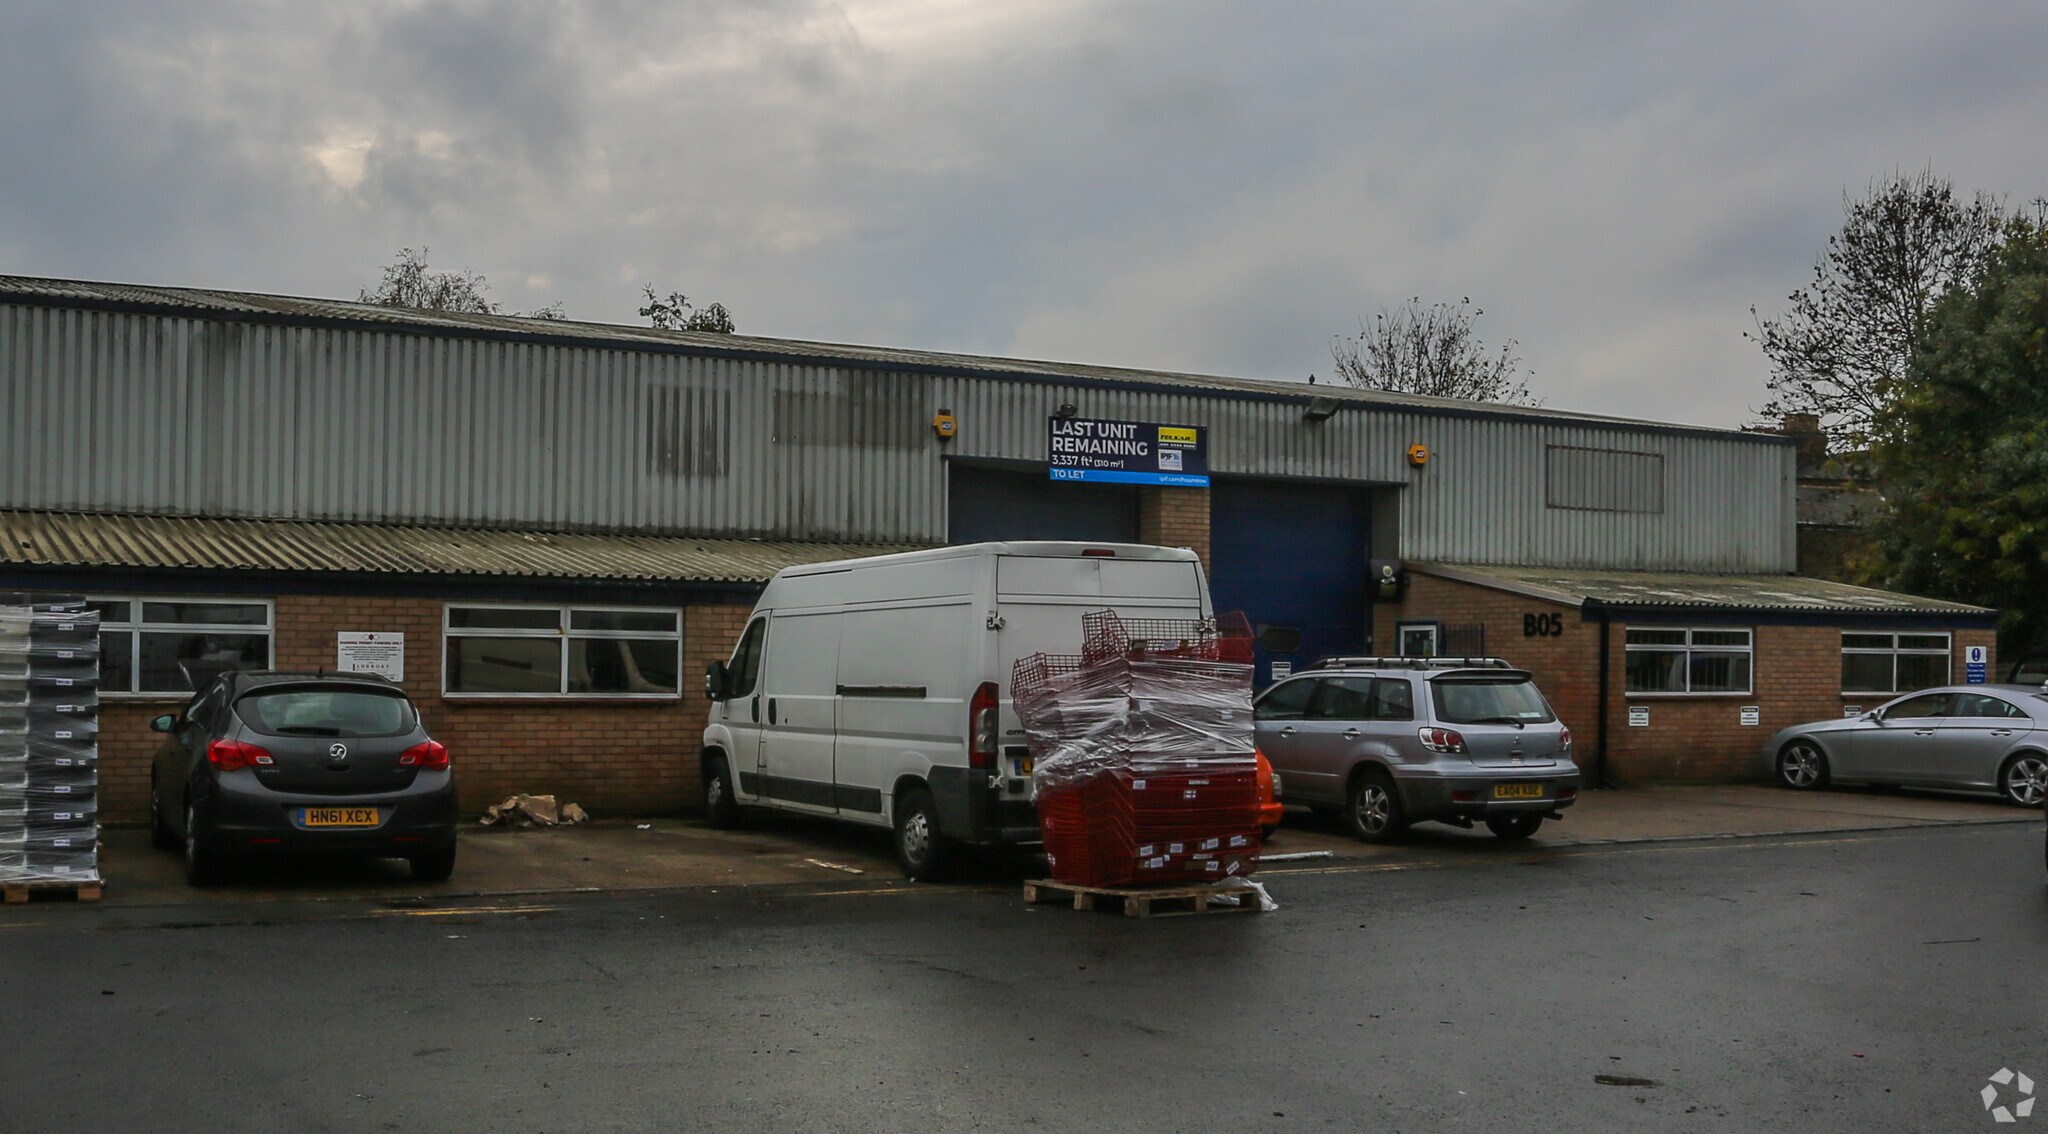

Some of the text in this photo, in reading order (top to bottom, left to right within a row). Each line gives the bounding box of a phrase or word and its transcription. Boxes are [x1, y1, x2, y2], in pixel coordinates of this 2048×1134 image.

[1052, 420, 1137, 439] LAST UNIT
[1052, 437, 1148, 456] REMAINING
[1052, 454, 1078, 466] 3,337
[1053, 469, 1085, 479] TO LET
[310, 810, 373, 823] HN61 XCX
